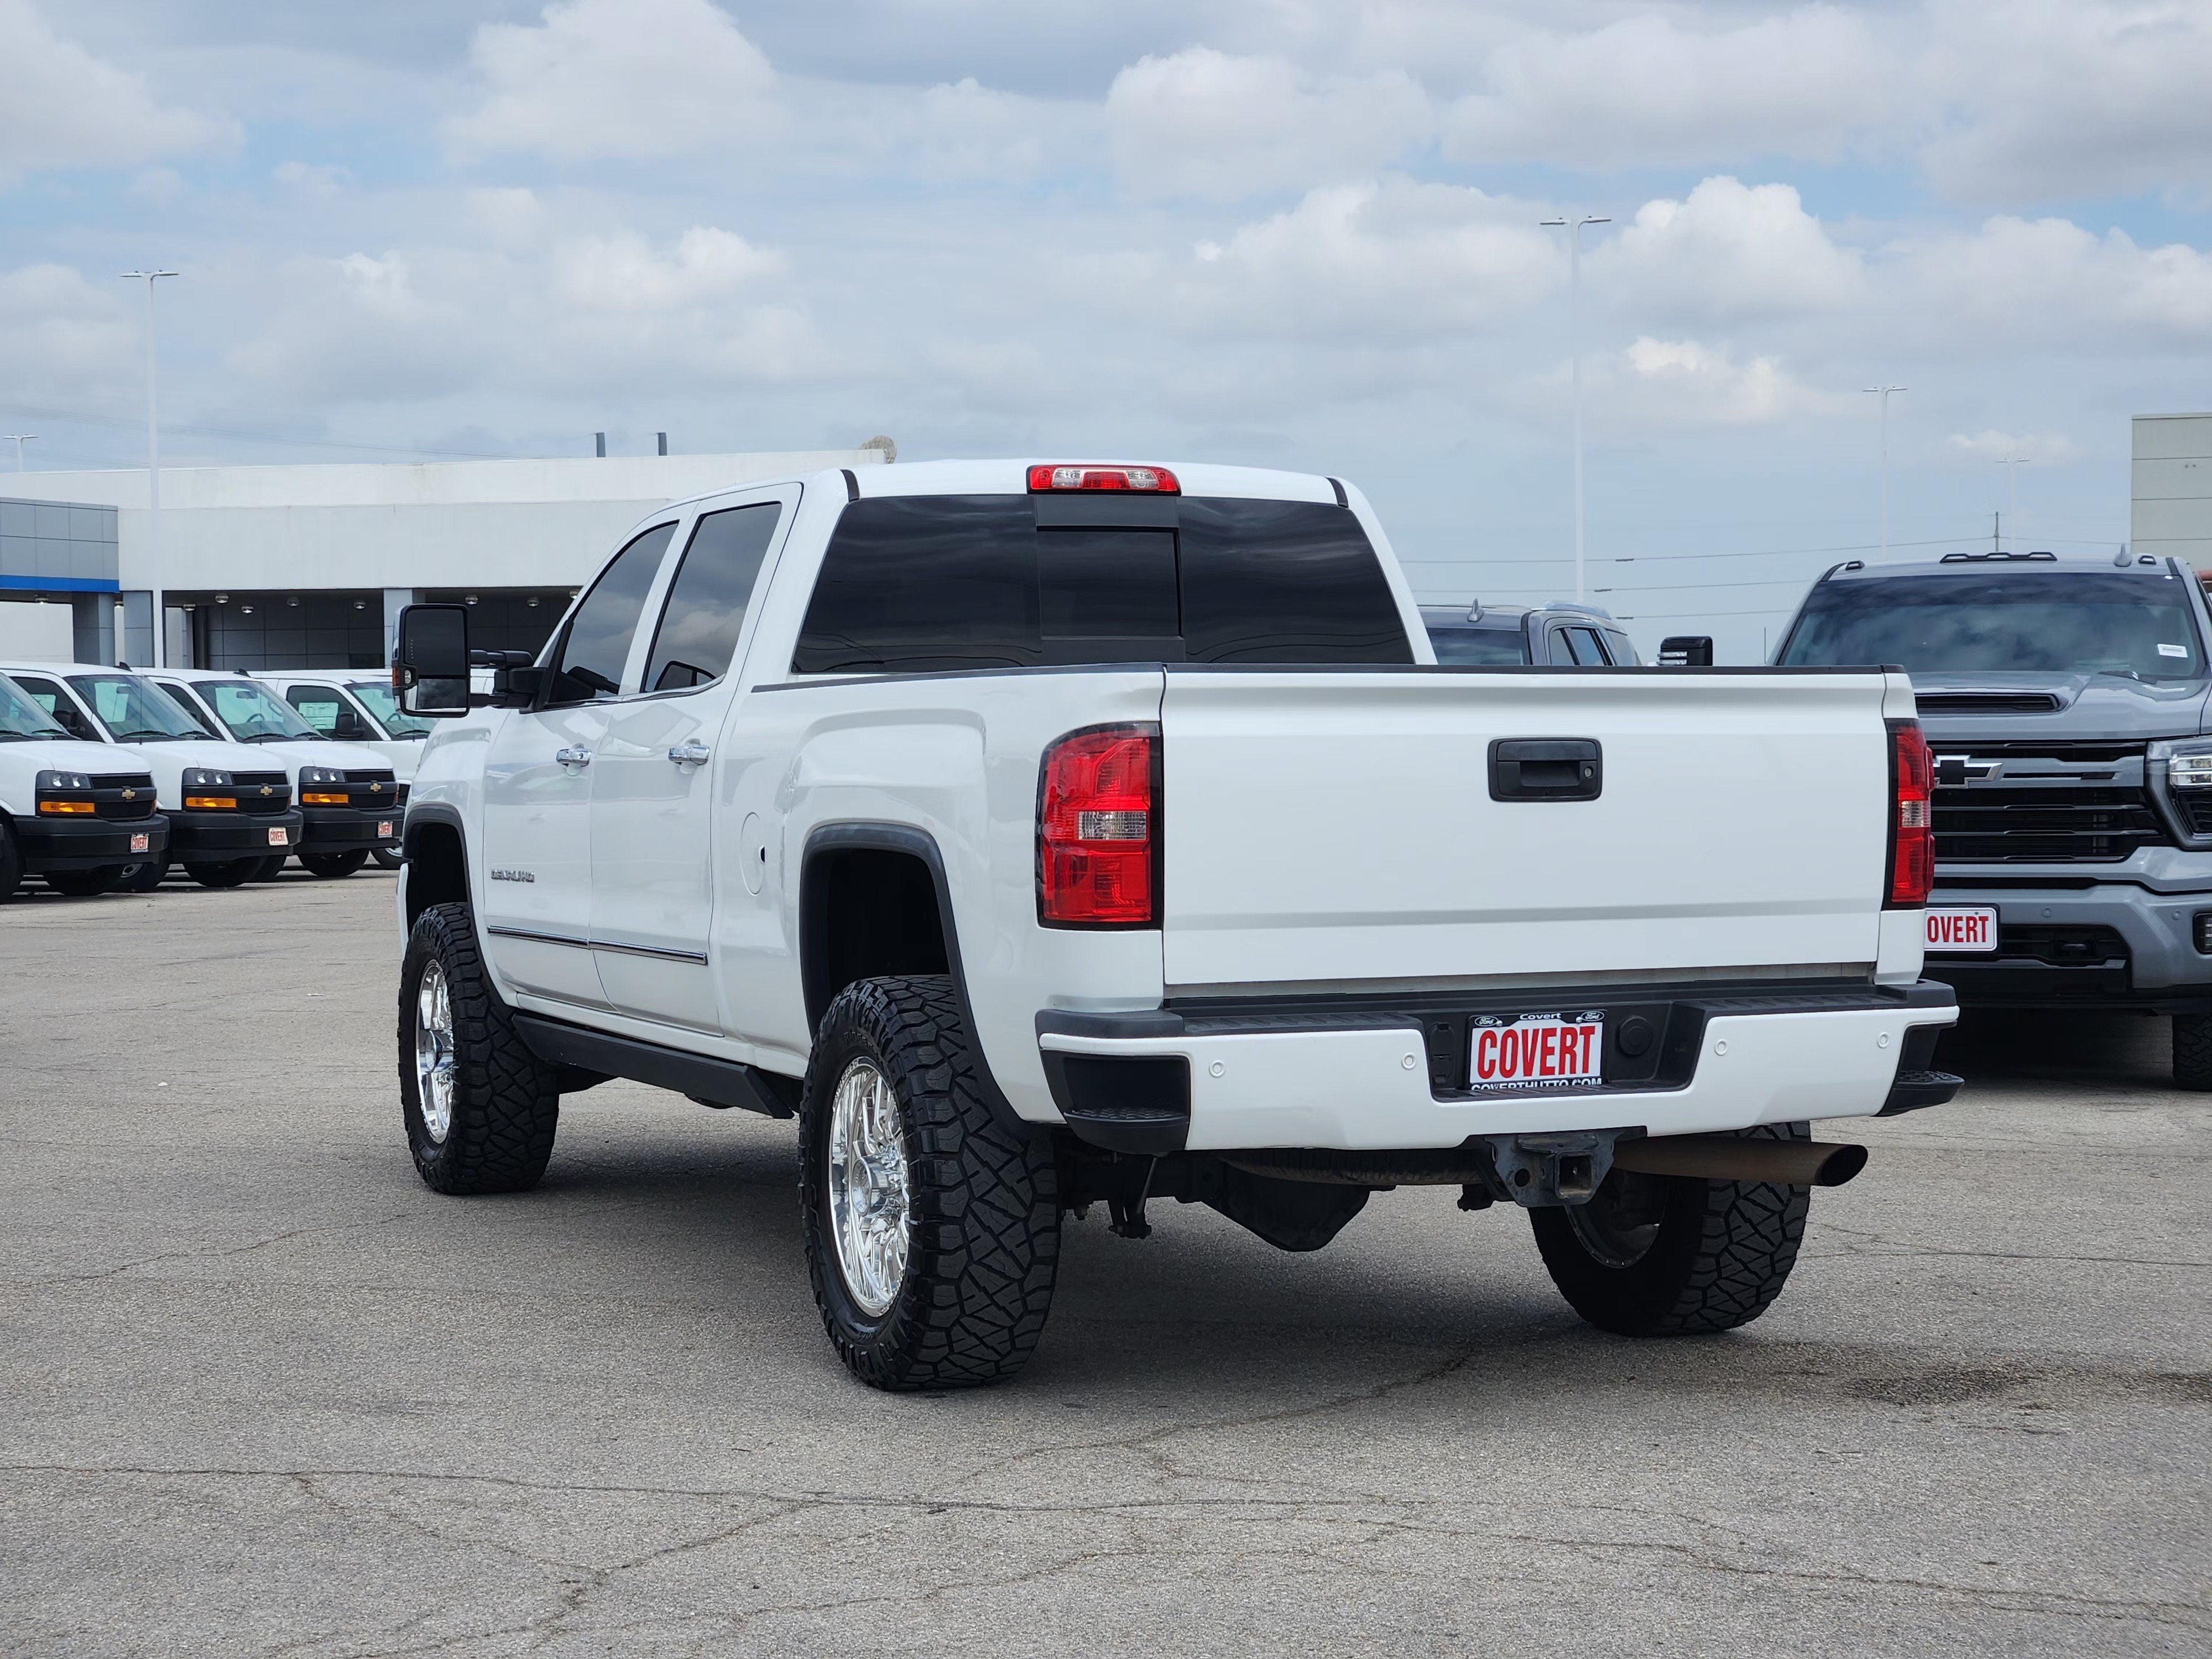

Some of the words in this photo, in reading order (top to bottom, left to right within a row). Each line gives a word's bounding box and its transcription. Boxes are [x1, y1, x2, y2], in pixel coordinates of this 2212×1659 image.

[1927, 916, 1989, 943] OVERT
[1478, 1025, 1596, 1079] COVERT
[1471, 1078, 1602, 1091] COVERTHUTTOCOM
